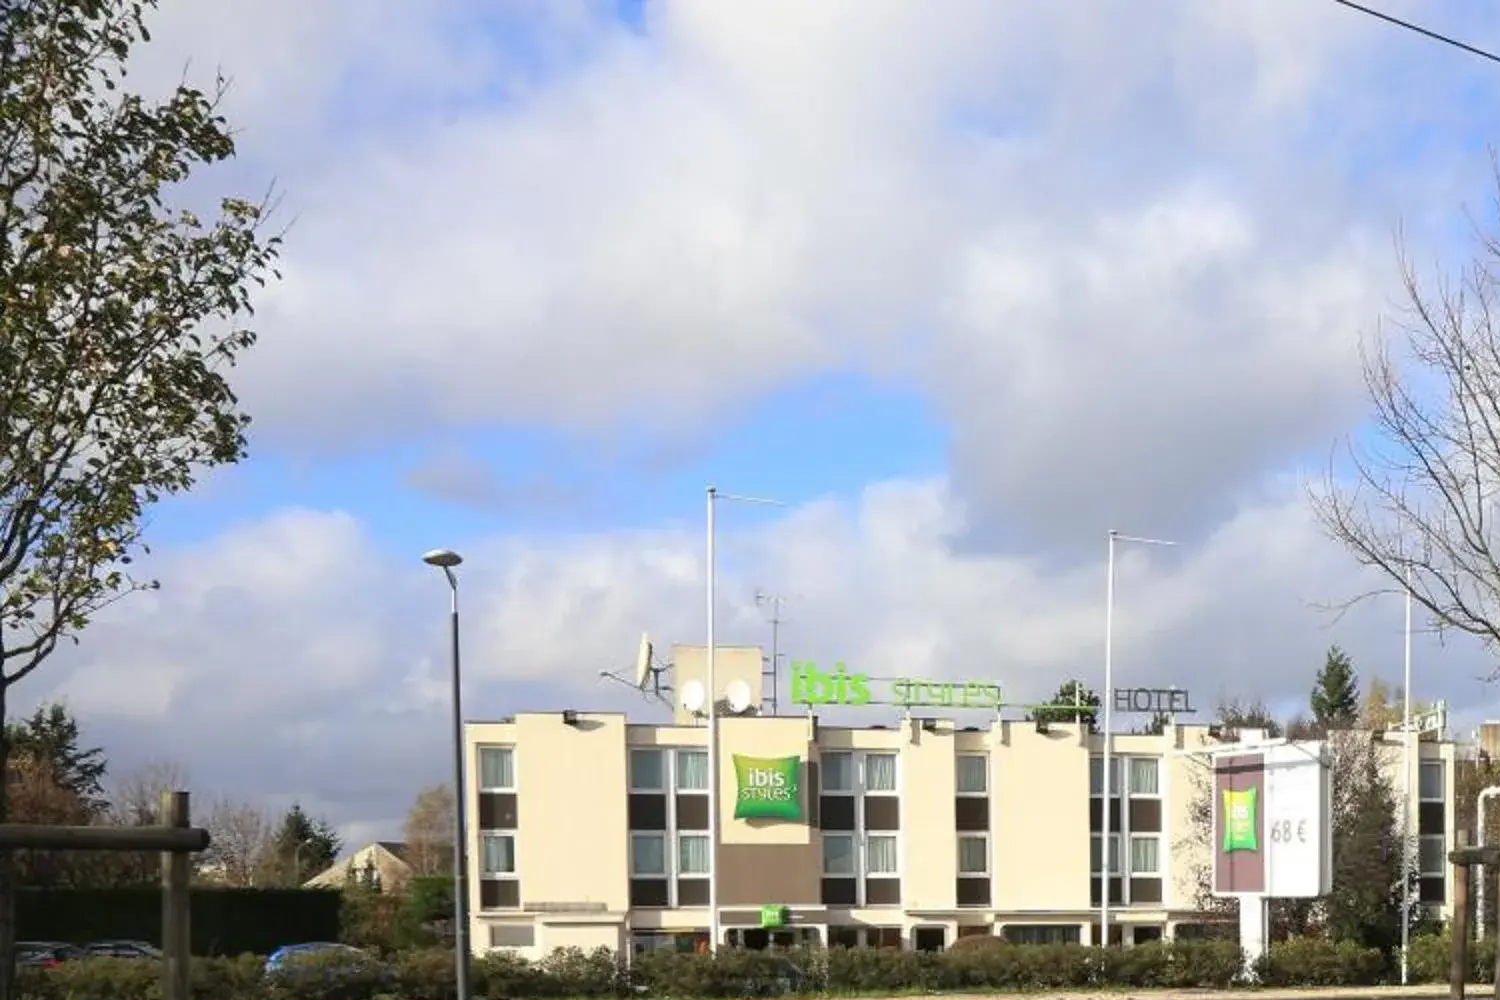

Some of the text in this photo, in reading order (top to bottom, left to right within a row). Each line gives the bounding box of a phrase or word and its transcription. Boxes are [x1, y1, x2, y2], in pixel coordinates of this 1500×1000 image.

[791, 661, 871, 705] ibis
[1114, 688, 1197, 712] HOTEL
[748, 767, 785, 787] ibis
